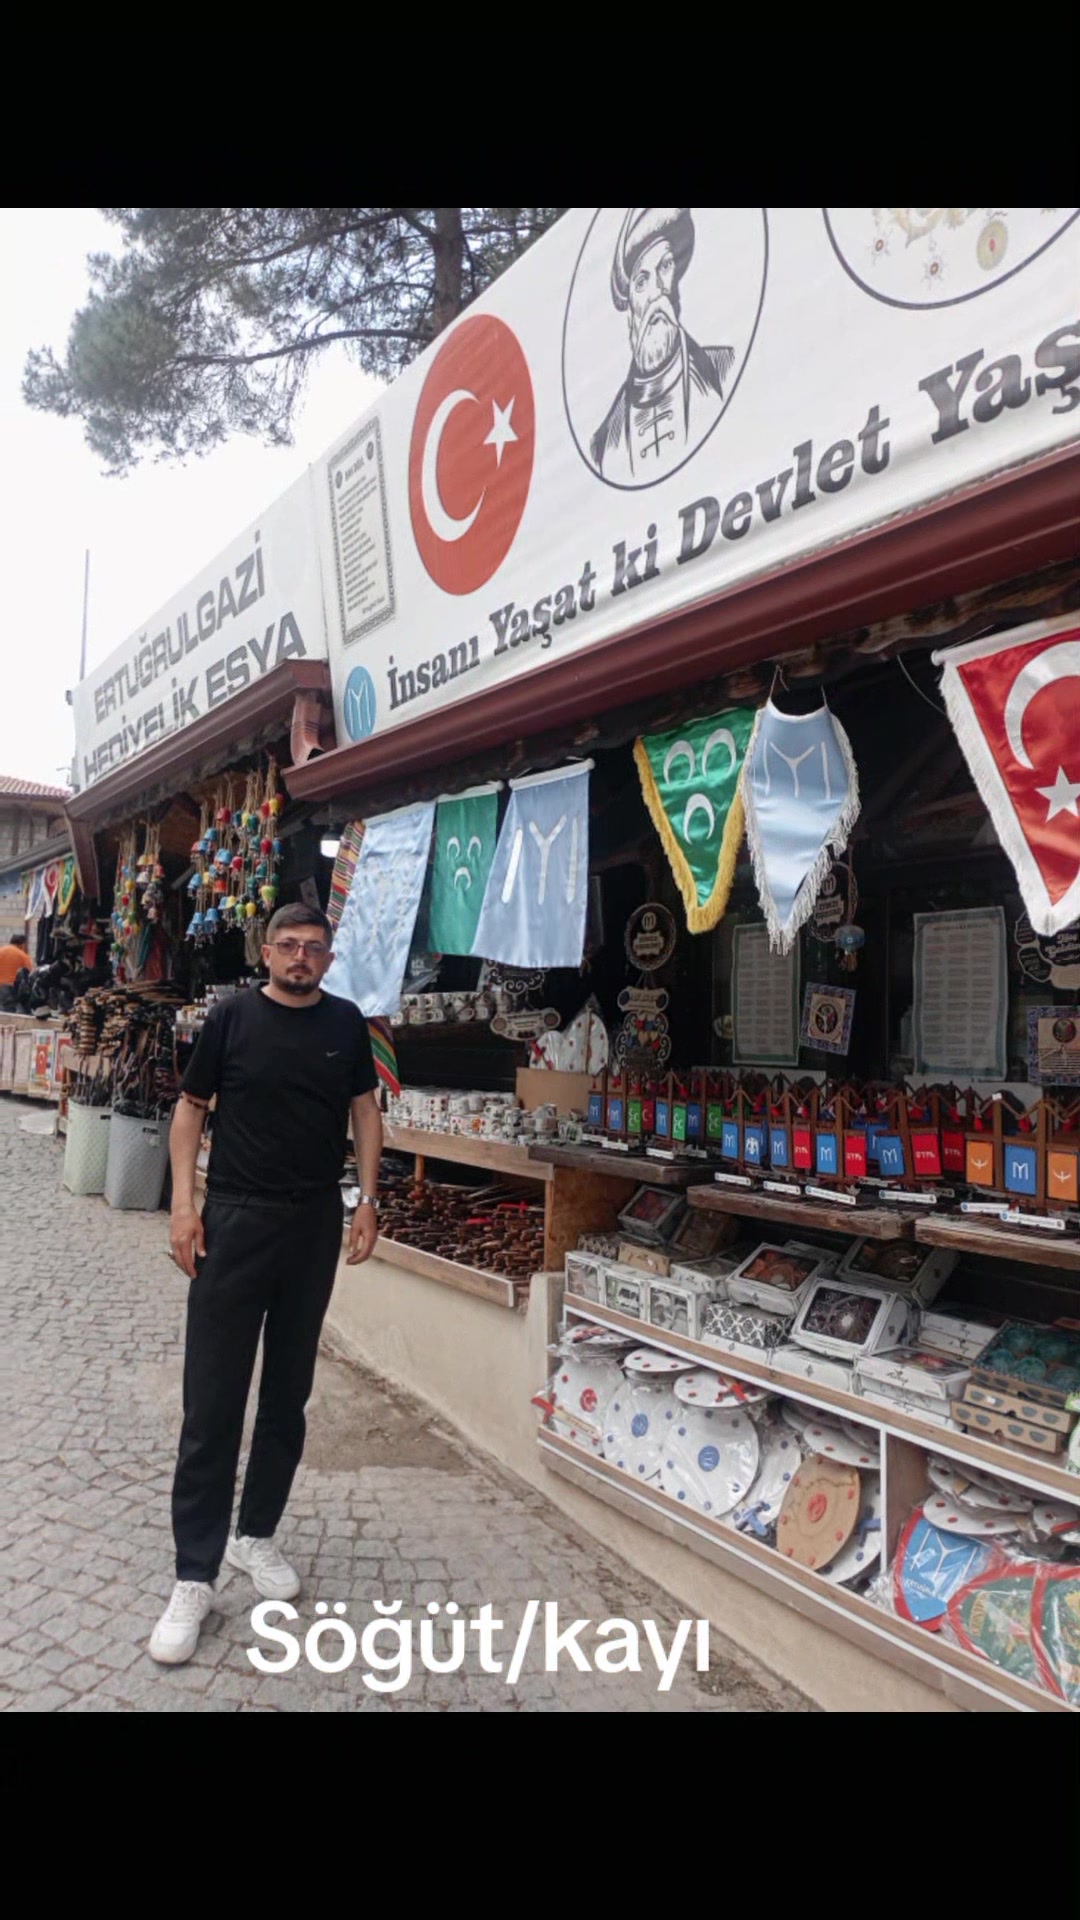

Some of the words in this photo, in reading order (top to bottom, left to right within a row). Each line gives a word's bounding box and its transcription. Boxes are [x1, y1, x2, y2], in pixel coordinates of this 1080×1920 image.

[387, 656, 480, 710] İnsanı
[489, 561, 596, 657] Yaşat
[610, 523, 660, 597] ki
[676, 404, 891, 564] Devlet
